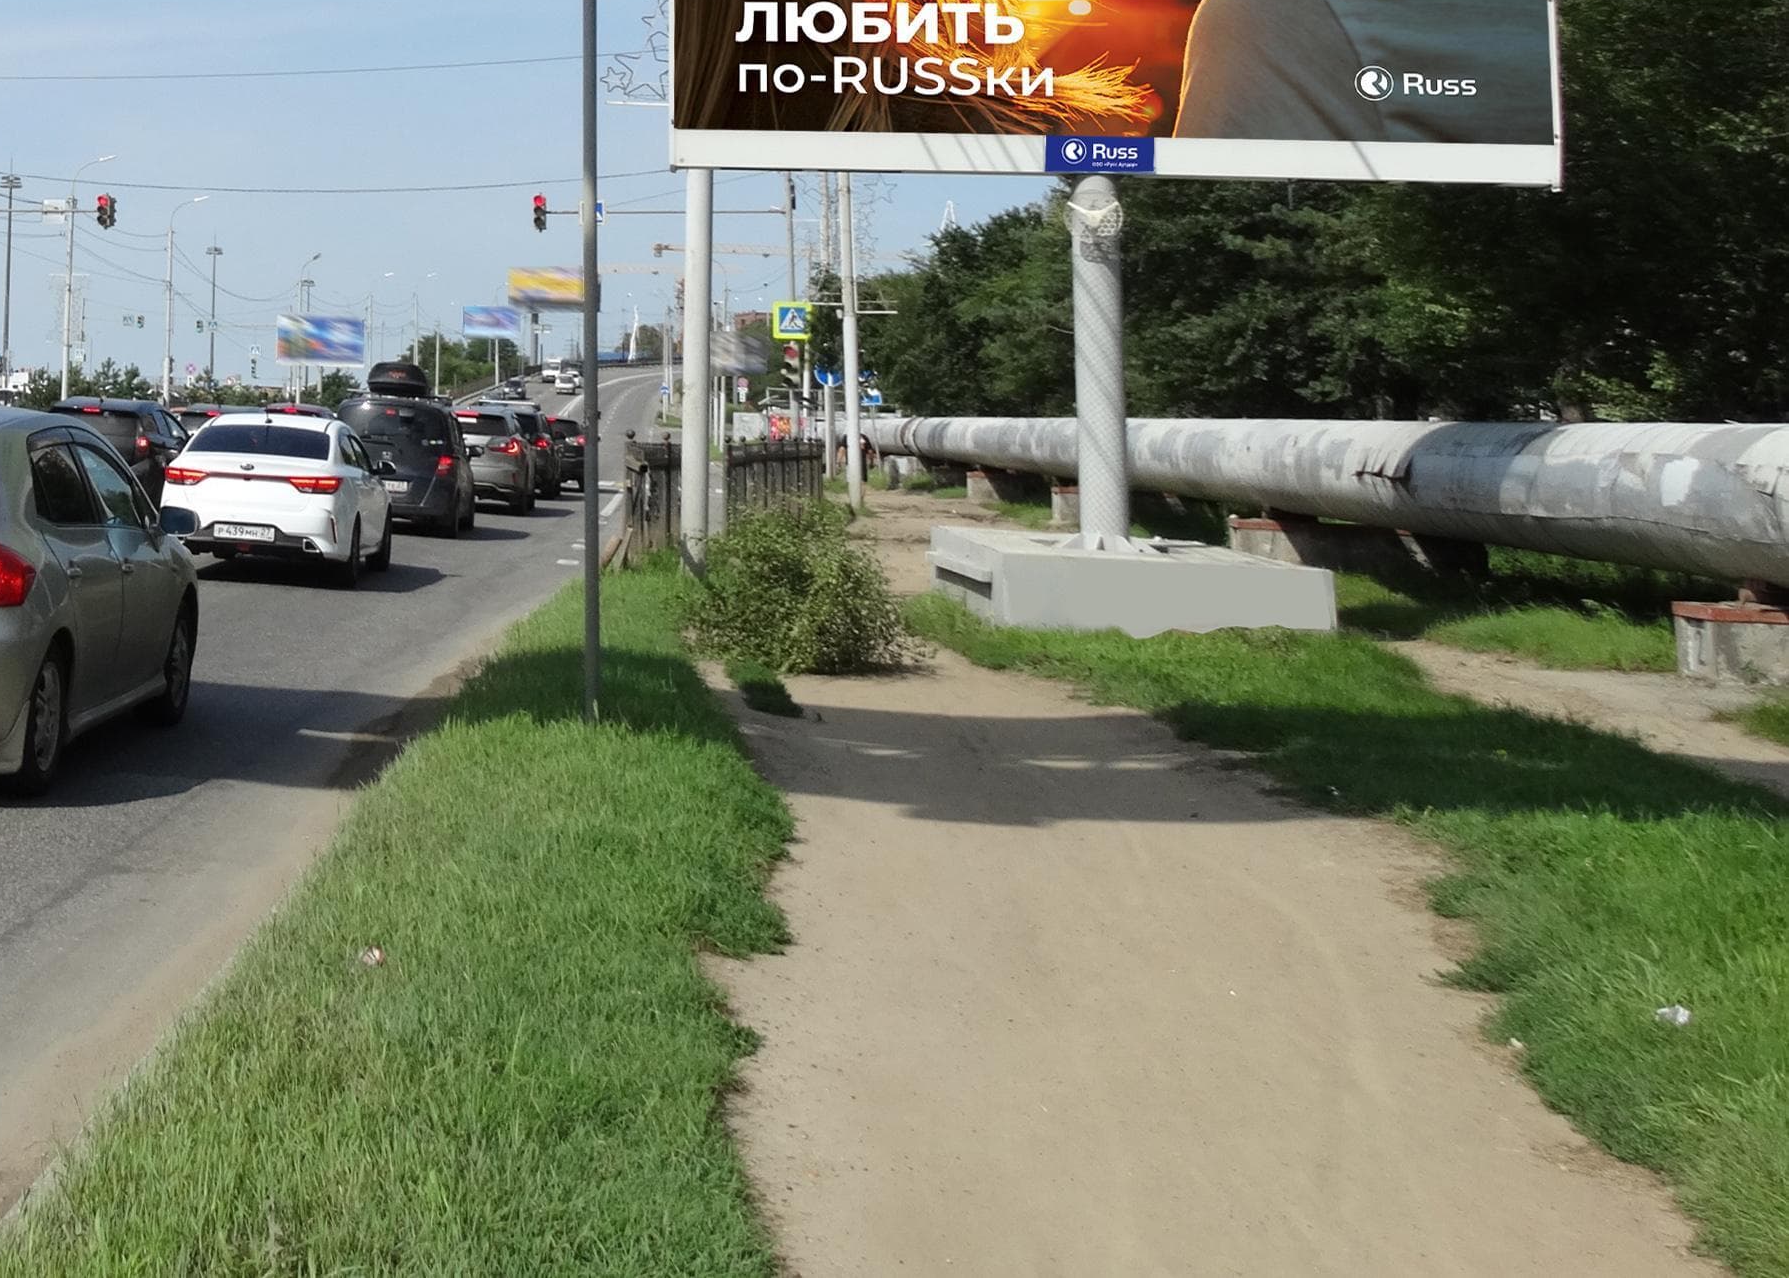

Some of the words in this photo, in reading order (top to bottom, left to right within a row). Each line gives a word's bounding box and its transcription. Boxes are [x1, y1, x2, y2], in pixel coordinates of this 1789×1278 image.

[735, 1, 1025, 44] ЛЮБИТЬ
[738, 55, 1054, 96] по-RUSSки
[1403, 73, 1477, 96] Russ
[1092, 143, 1138, 159] Russ
